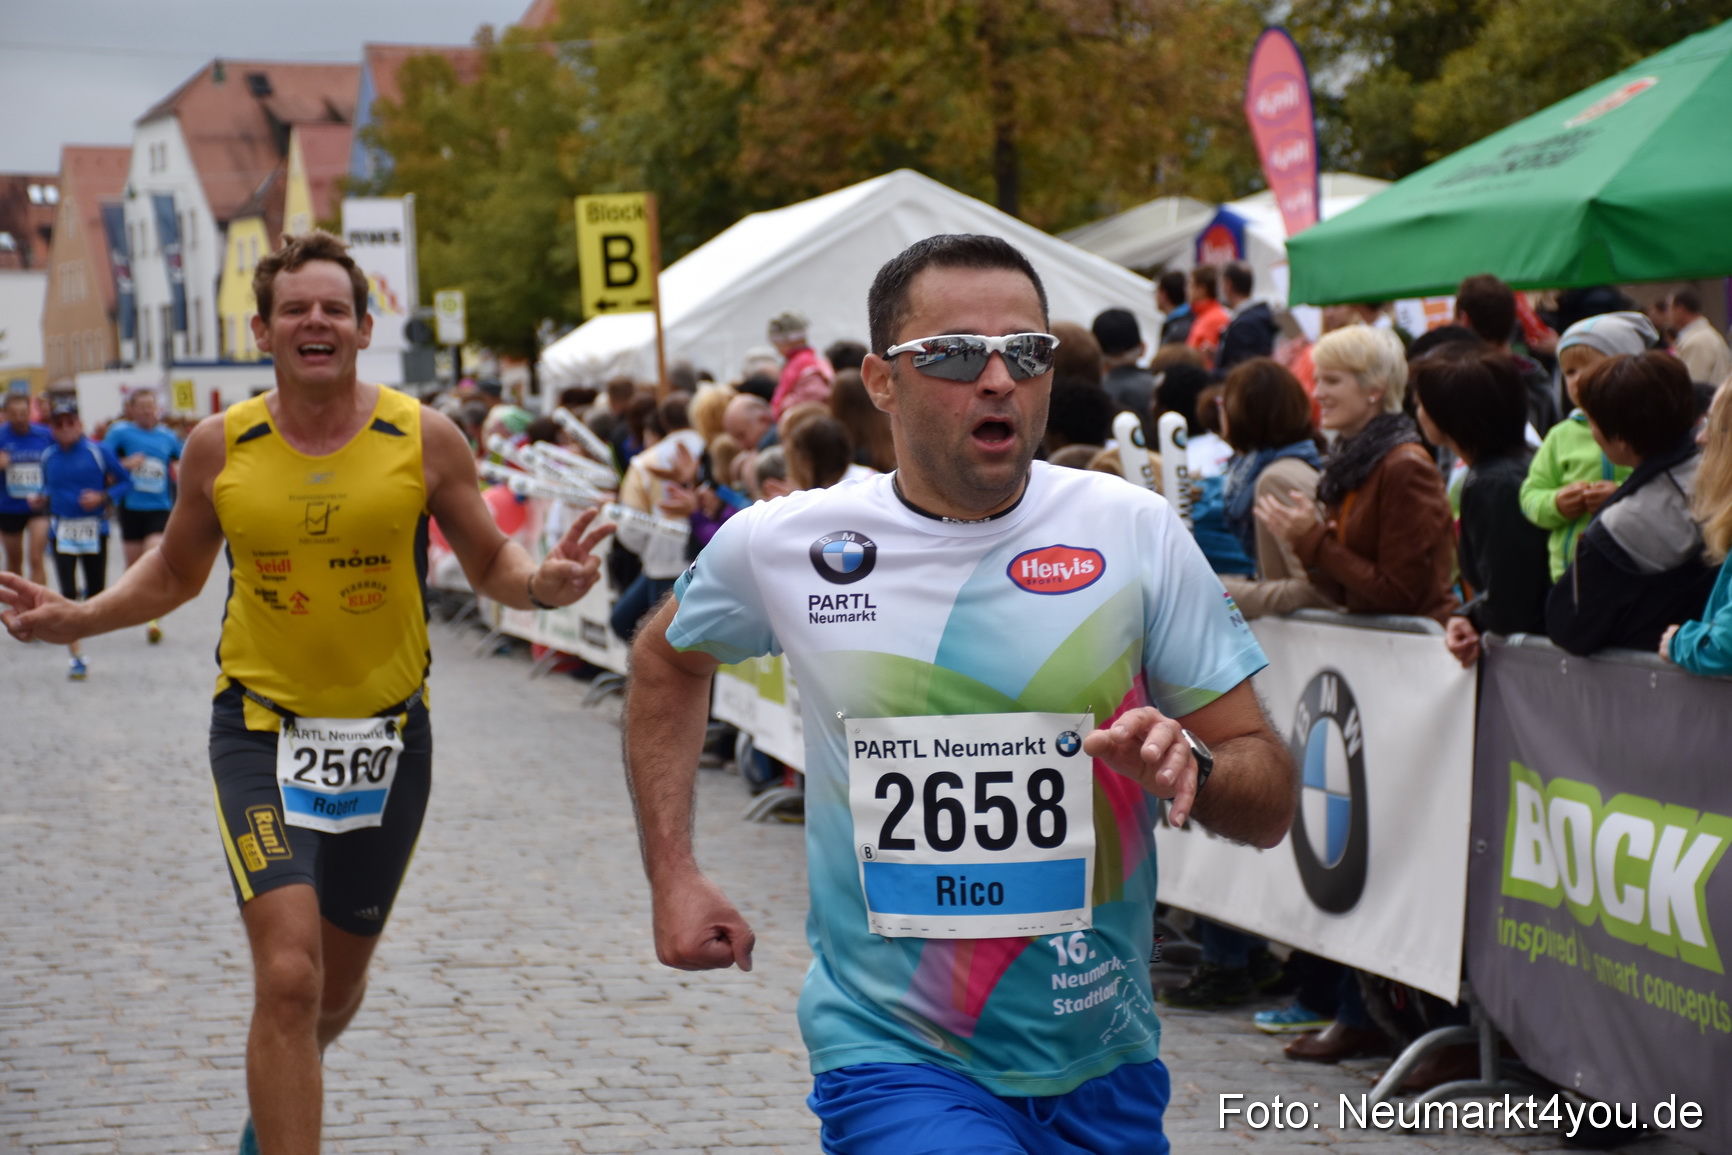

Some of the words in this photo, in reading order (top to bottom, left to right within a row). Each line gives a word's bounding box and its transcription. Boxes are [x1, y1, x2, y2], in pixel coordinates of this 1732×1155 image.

[602, 236, 638, 288] B
[255, 559, 292, 574] Seidl
[1021, 557, 1095, 580] Hervis
[1026, 577, 1063, 586] SPORTS
[809, 594, 877, 611] PARTL
[809, 610, 877, 624] Neumarkt
[1296, 674, 1363, 759] BMW
[854, 739, 927, 759] PARTL
[934, 737, 1046, 758] Neumarkt
[293, 746, 393, 787] 2560
[313, 797, 360, 817] Robert
[875, 768, 1068, 852] 2658
[864, 846, 873, 859] B
[1510, 779, 1723, 949] BOCK
[936, 875, 1005, 906] Rico
[1048, 932, 1097, 966] 16.
[1497, 905, 1578, 967] inspired
[1642, 972, 1732, 1035] concepts
[1053, 976, 1123, 1016] Stadtlauf
